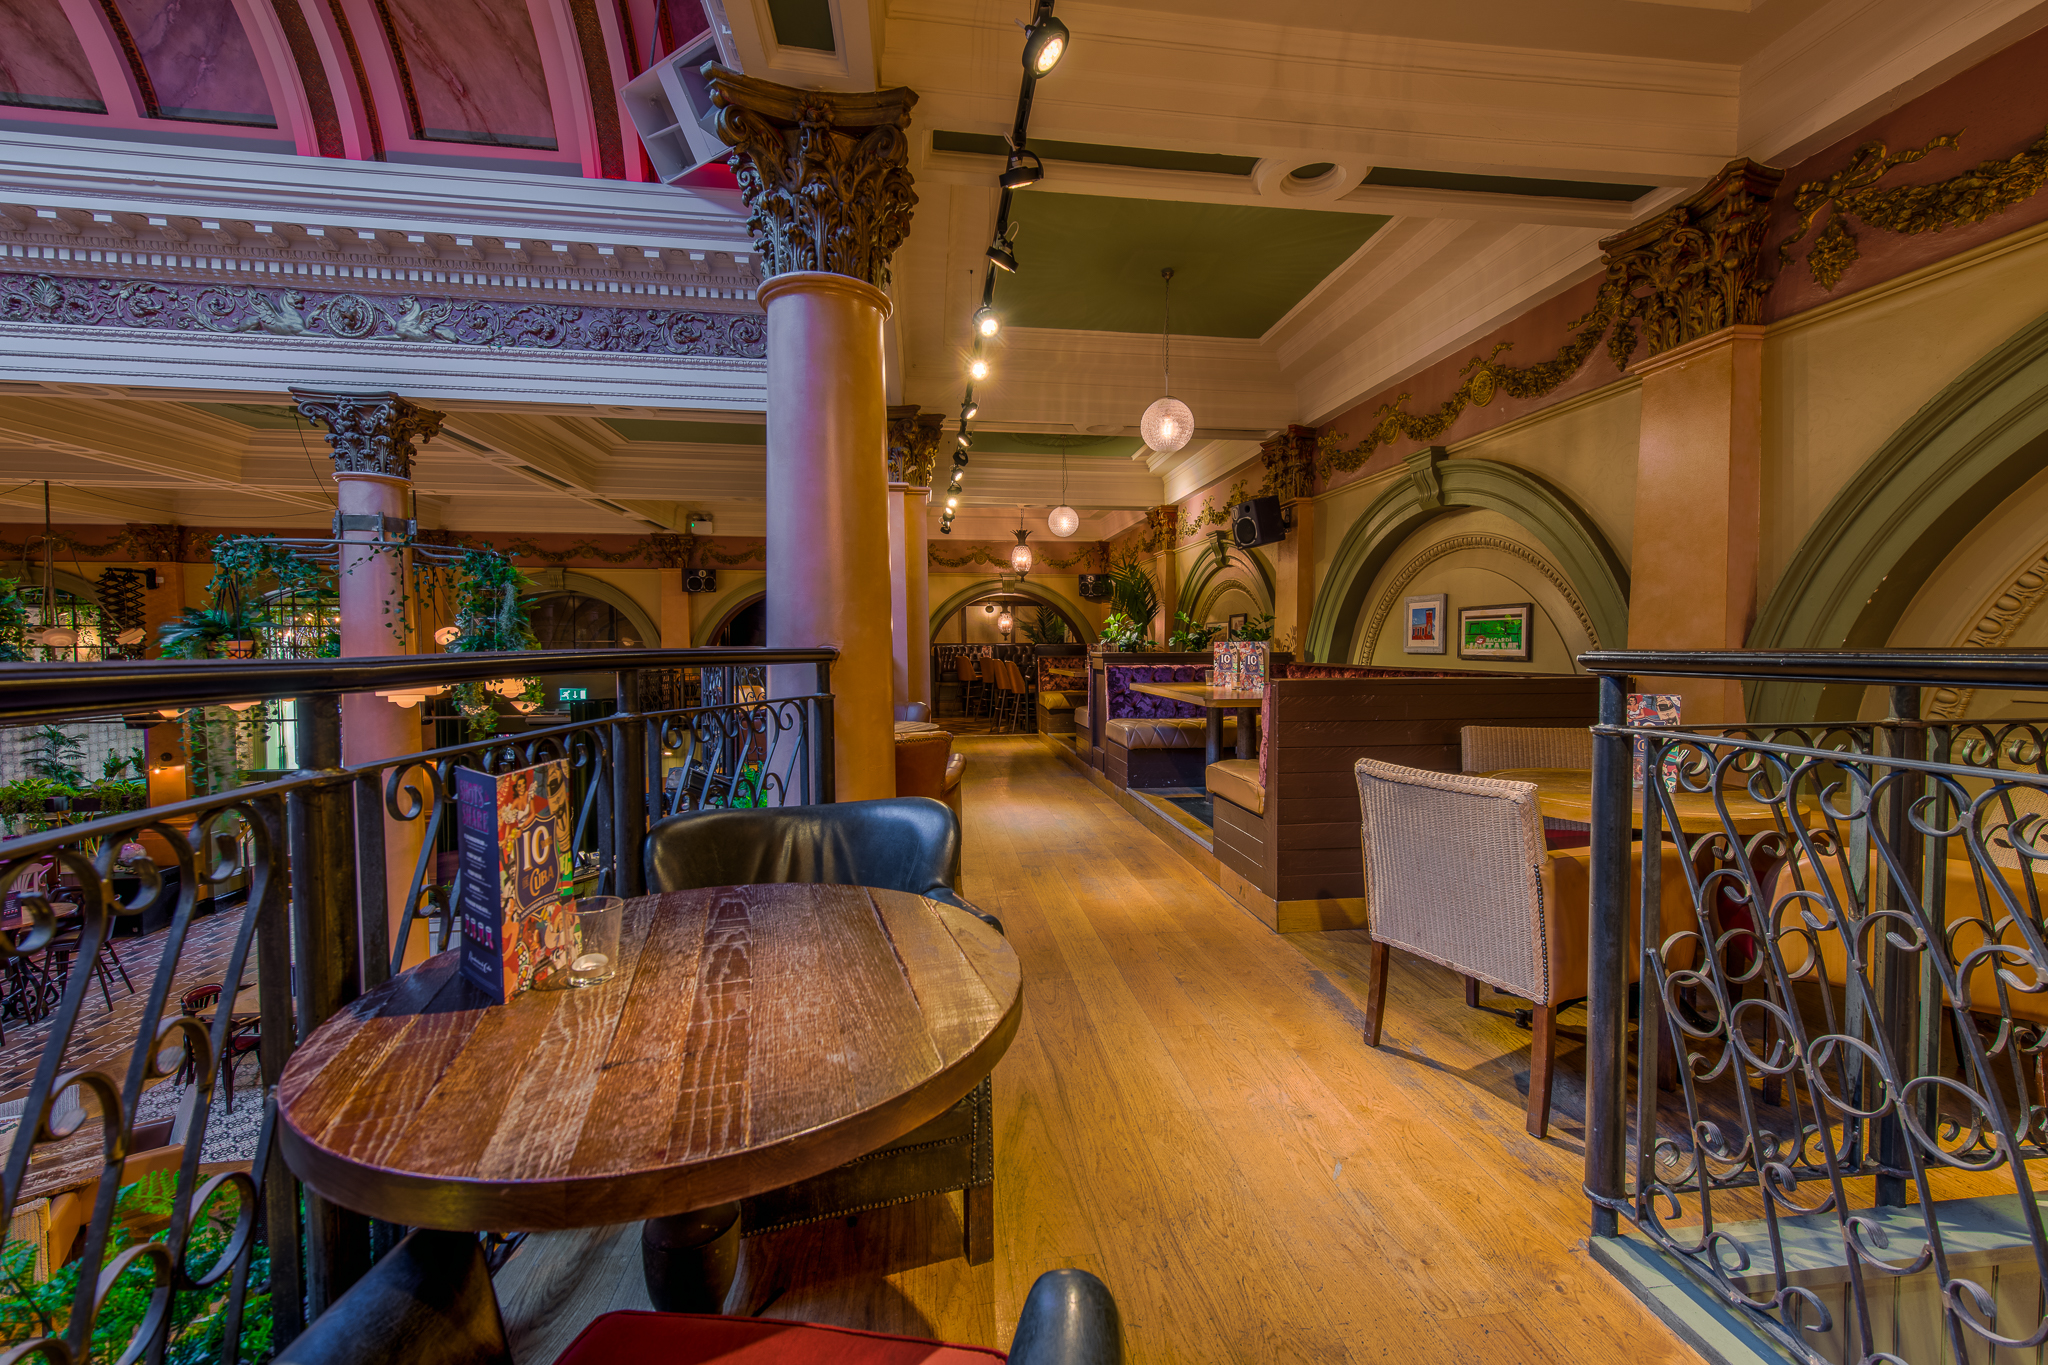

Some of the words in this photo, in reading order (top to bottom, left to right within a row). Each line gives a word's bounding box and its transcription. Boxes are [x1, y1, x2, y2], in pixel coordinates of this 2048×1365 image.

[462, 803, 489, 834] SHARE
[523, 825, 551, 871] 10
[529, 865, 554, 896] CUBA
